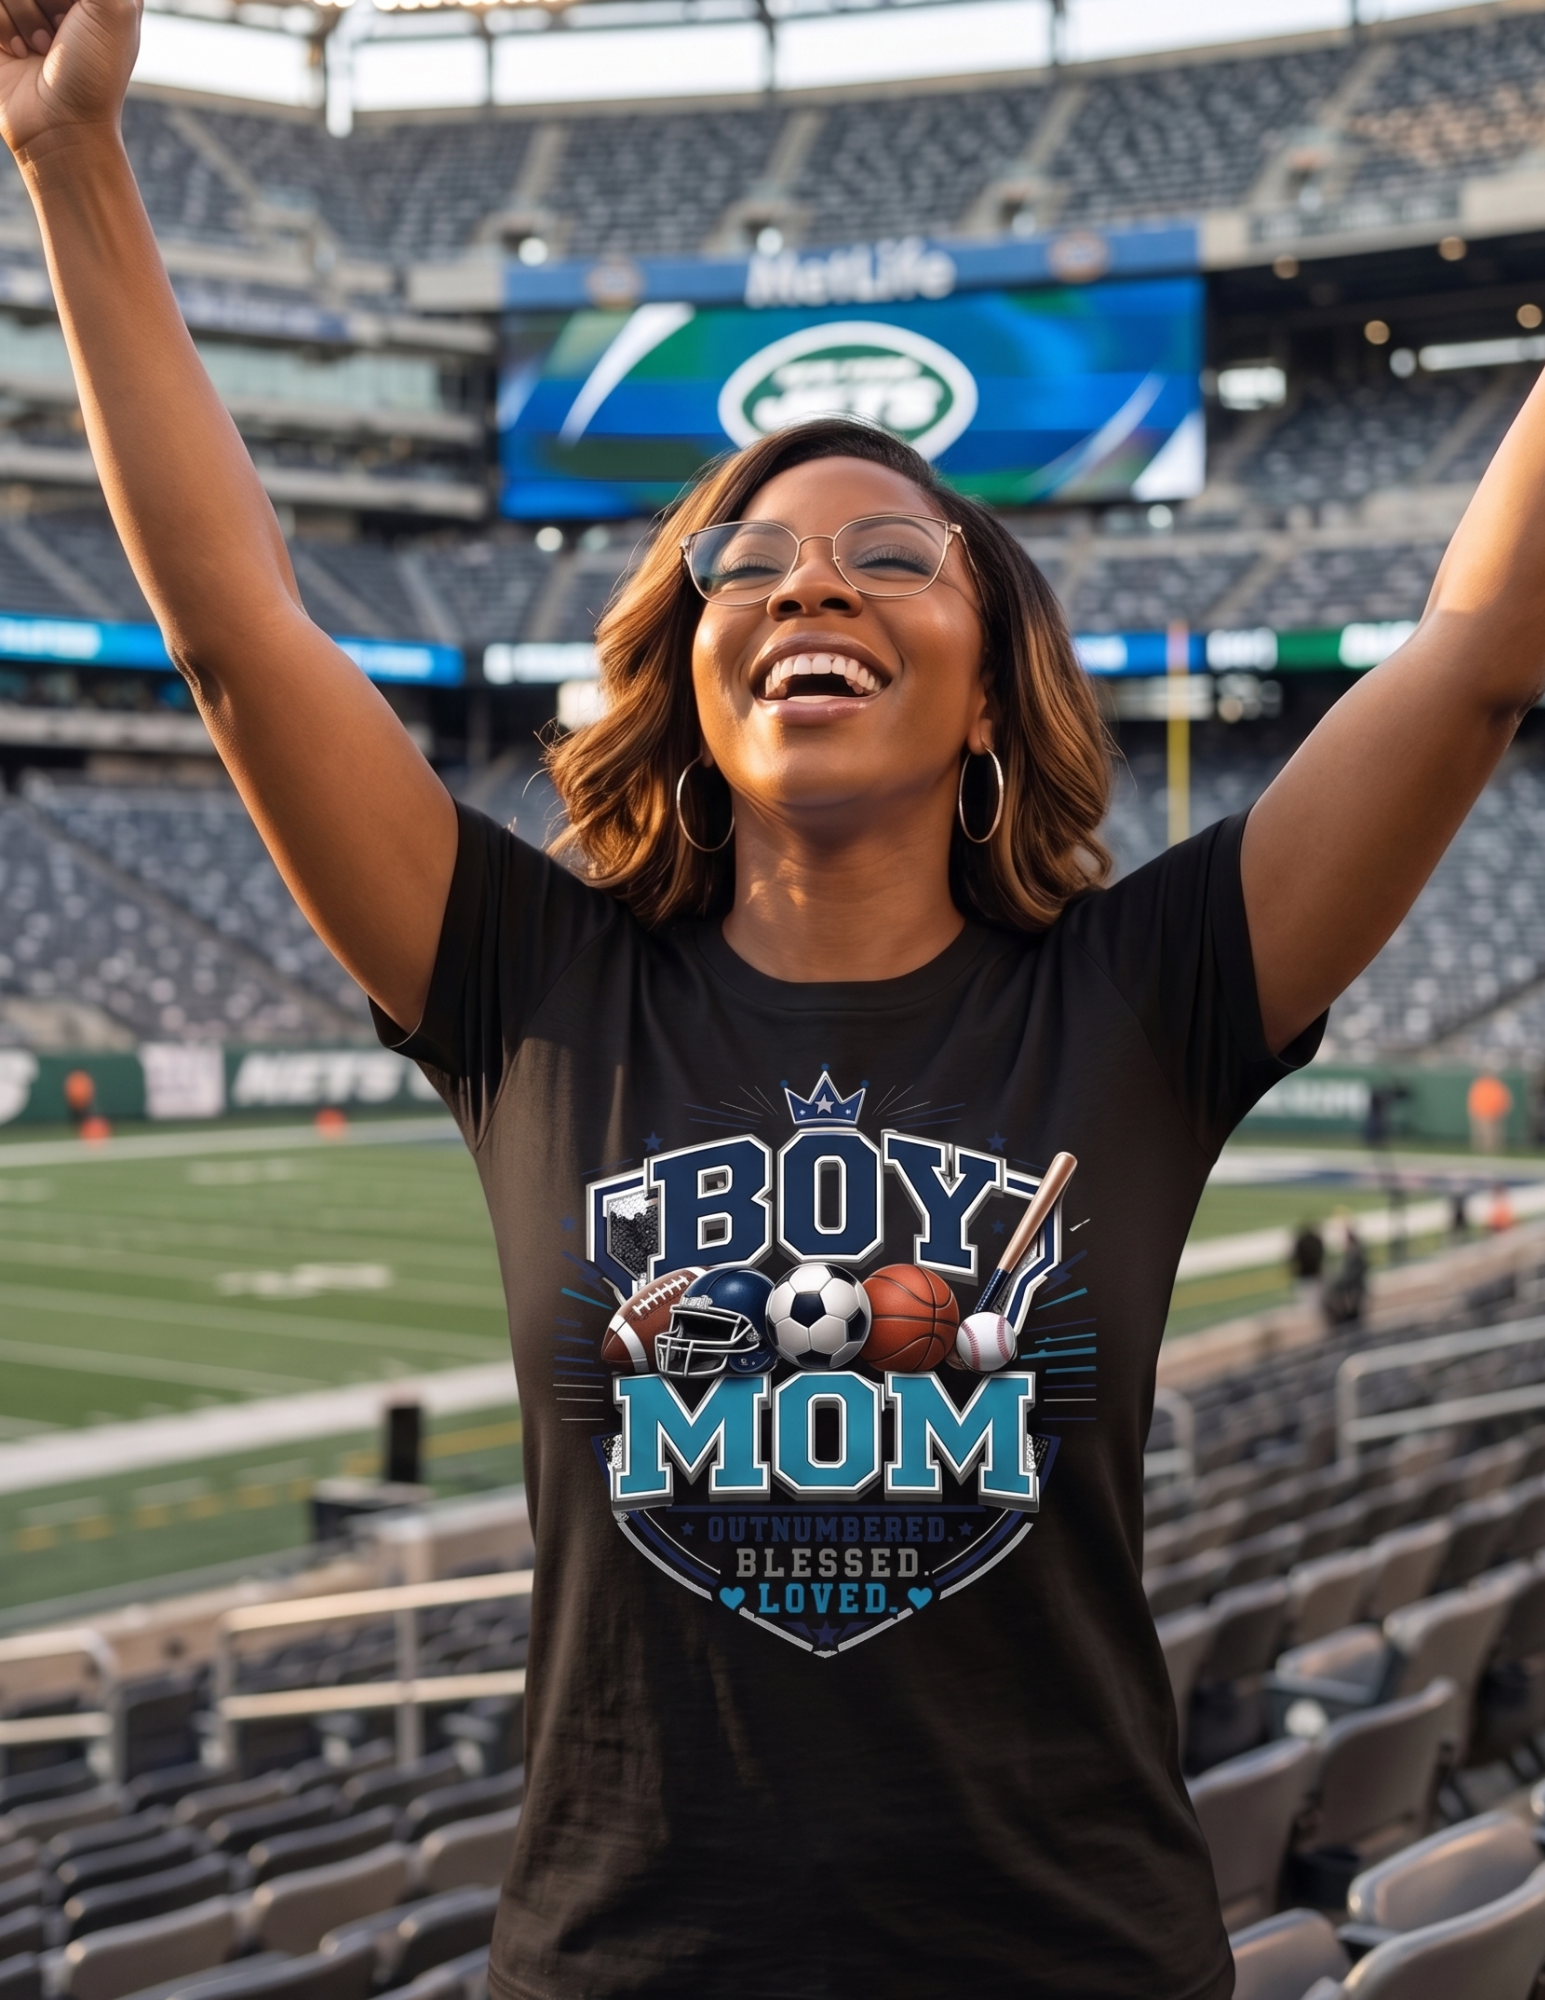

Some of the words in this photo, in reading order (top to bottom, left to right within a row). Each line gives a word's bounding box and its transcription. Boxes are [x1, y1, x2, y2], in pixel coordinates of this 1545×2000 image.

[647, 1129, 1006, 1279] BOY
[613, 1371, 1038, 1508] MOM
[708, 1516, 954, 1542] OUTNUMBERED.
[736, 1548, 930, 1577] BLESSED.
[758, 1583, 898, 1613] LOVED.
